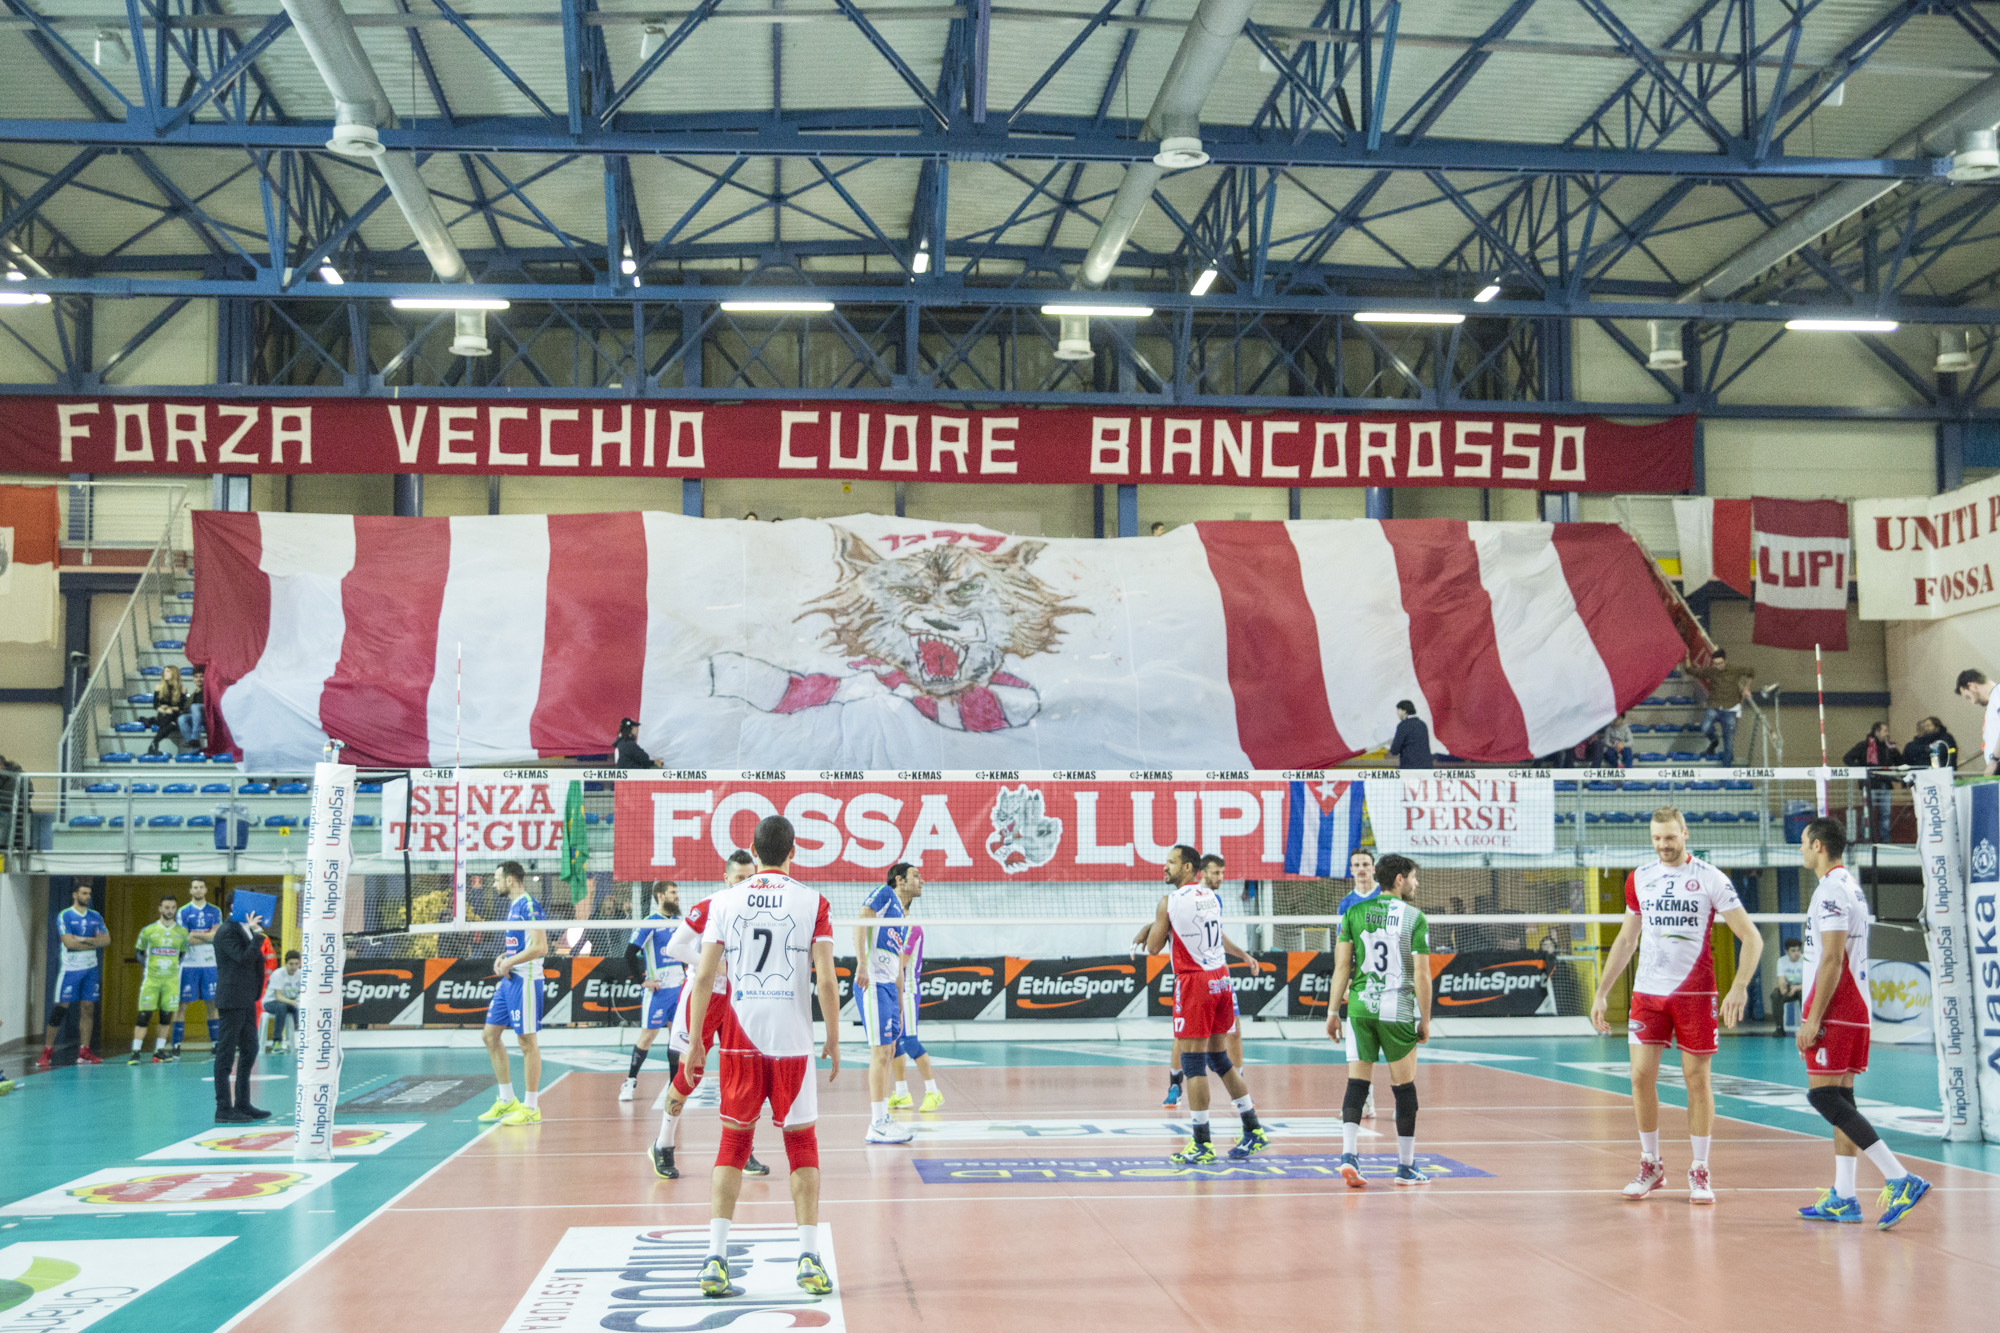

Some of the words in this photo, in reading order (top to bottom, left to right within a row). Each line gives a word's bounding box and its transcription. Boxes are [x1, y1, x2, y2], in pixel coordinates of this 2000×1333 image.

[57, 403, 312, 464] FORZA
[387, 404, 706, 468] VECCHIO
[778, 410, 1020, 475] CUORE
[1089, 416, 1587, 482] BIANCOROSSO
[1874, 502, 1980, 551] UNITI
[1759, 545, 1844, 589] LUPI
[1914, 563, 1995, 606] FOSSA
[411, 784, 555, 815] SENZA
[1401, 778, 1518, 803] MENTI
[325, 786, 345, 846] UnipolSai
[651, 790, 973, 869] FOSSA
[1074, 790, 1285, 867] LUPI
[1402, 806, 1517, 831] PERSE
[1923, 785, 1946, 844] UnipolSai
[390, 821, 565, 852] TREGUA
[1410, 834, 1460, 847] SANTA
[1464, 834, 1512, 847] CROCE
[322, 859, 341, 919] UnipolSai
[747, 894, 783, 908] COLLI
[1665, 881, 1675, 895] 2
[1931, 855, 1953, 914] UnipolSai
[1204, 919, 1219, 947] 17
[1366, 912, 1399, 927] BONAMI
[319, 932, 339, 994] UnipolSai
[753, 928, 773, 973] 7
[1373, 941, 1388, 973] 3
[1937, 925, 1958, 985] UnipolSai
[1017, 974, 1135, 1000] EthicSport
[1438, 971, 1548, 994] EthicSport
[510, 1009, 521, 1021] 18
[1174, 1017, 1185, 1033] 17
[1943, 996, 1964, 1056] UnipolSai
[315, 1008, 333, 1070] UnipolSai
[1815, 1047, 1827, 1066] 4
[311, 1083, 330, 1145] UnipolSa
[1949, 1066, 1970, 1126] UnipolSai
